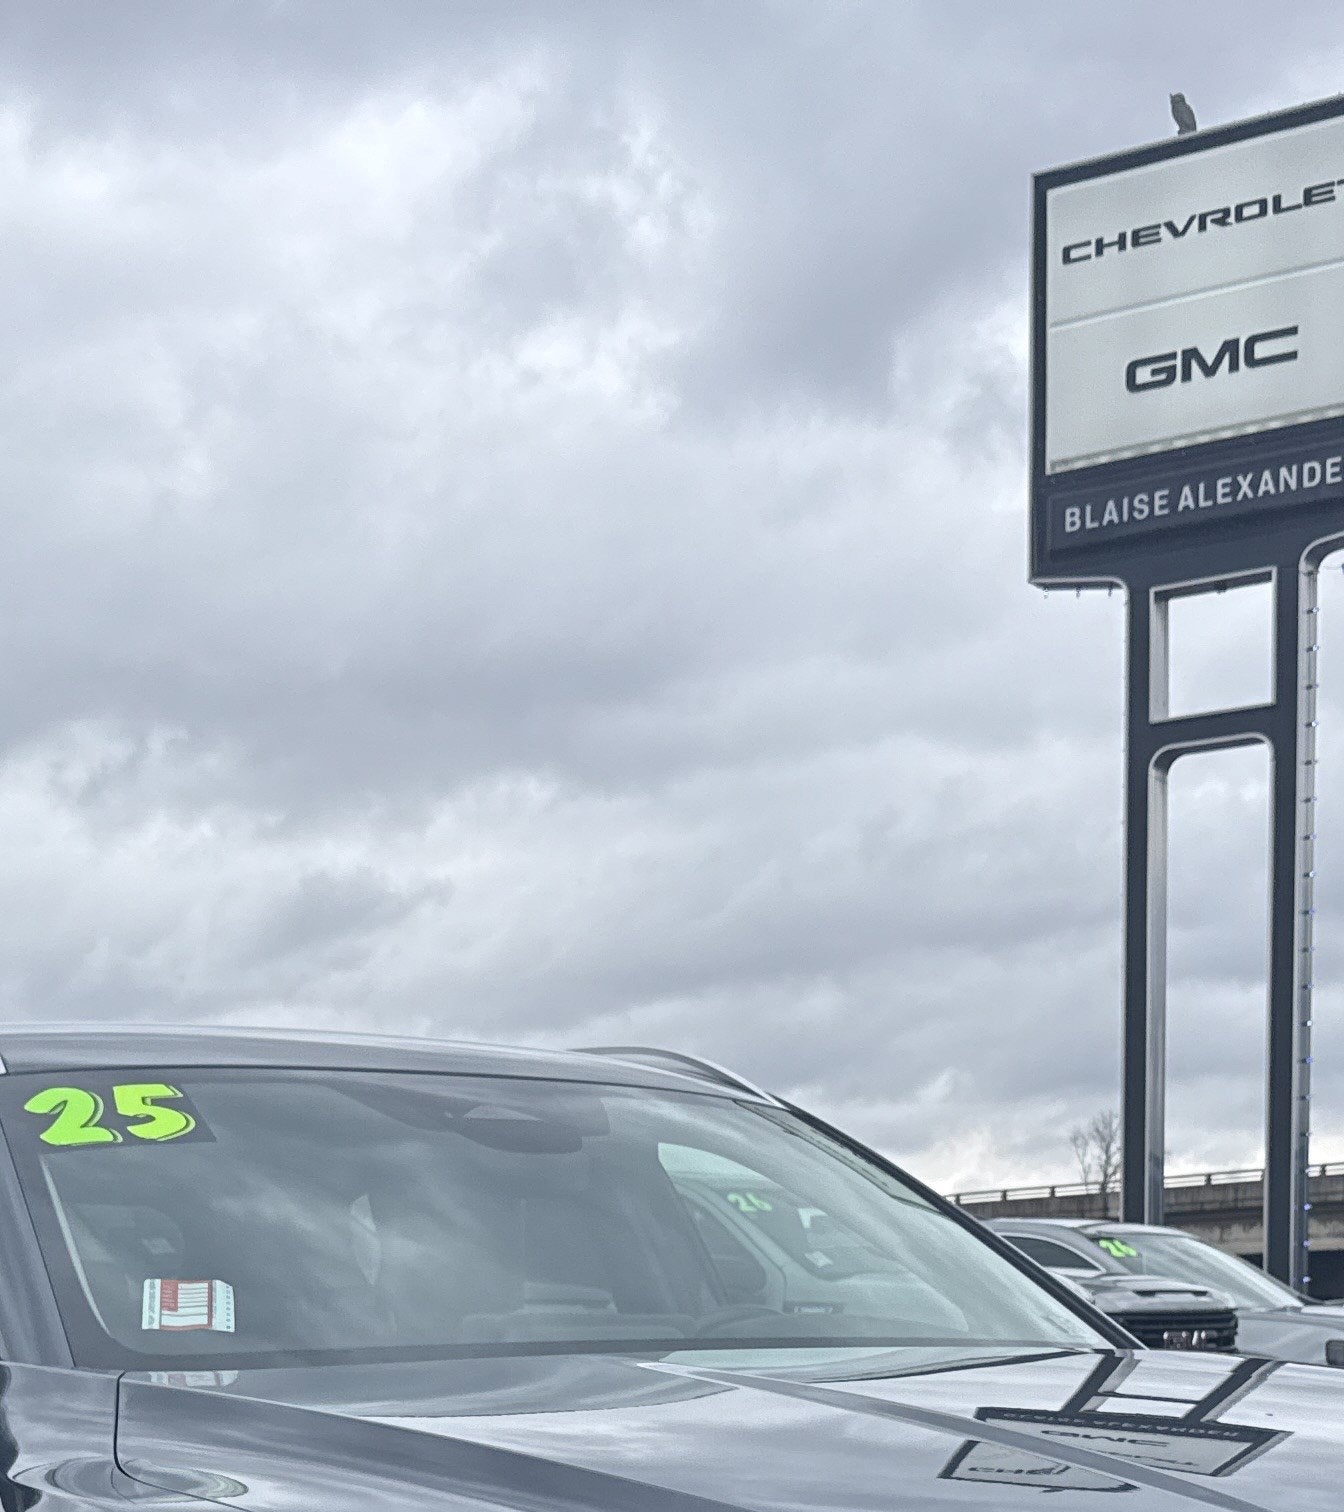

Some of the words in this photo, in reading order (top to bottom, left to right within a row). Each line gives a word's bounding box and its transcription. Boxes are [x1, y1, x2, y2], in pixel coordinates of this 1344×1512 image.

[1125, 325, 1299, 394] GMC
[1064, 489, 1170, 533] BLAISE
[23, 1083, 196, 1146] 25
